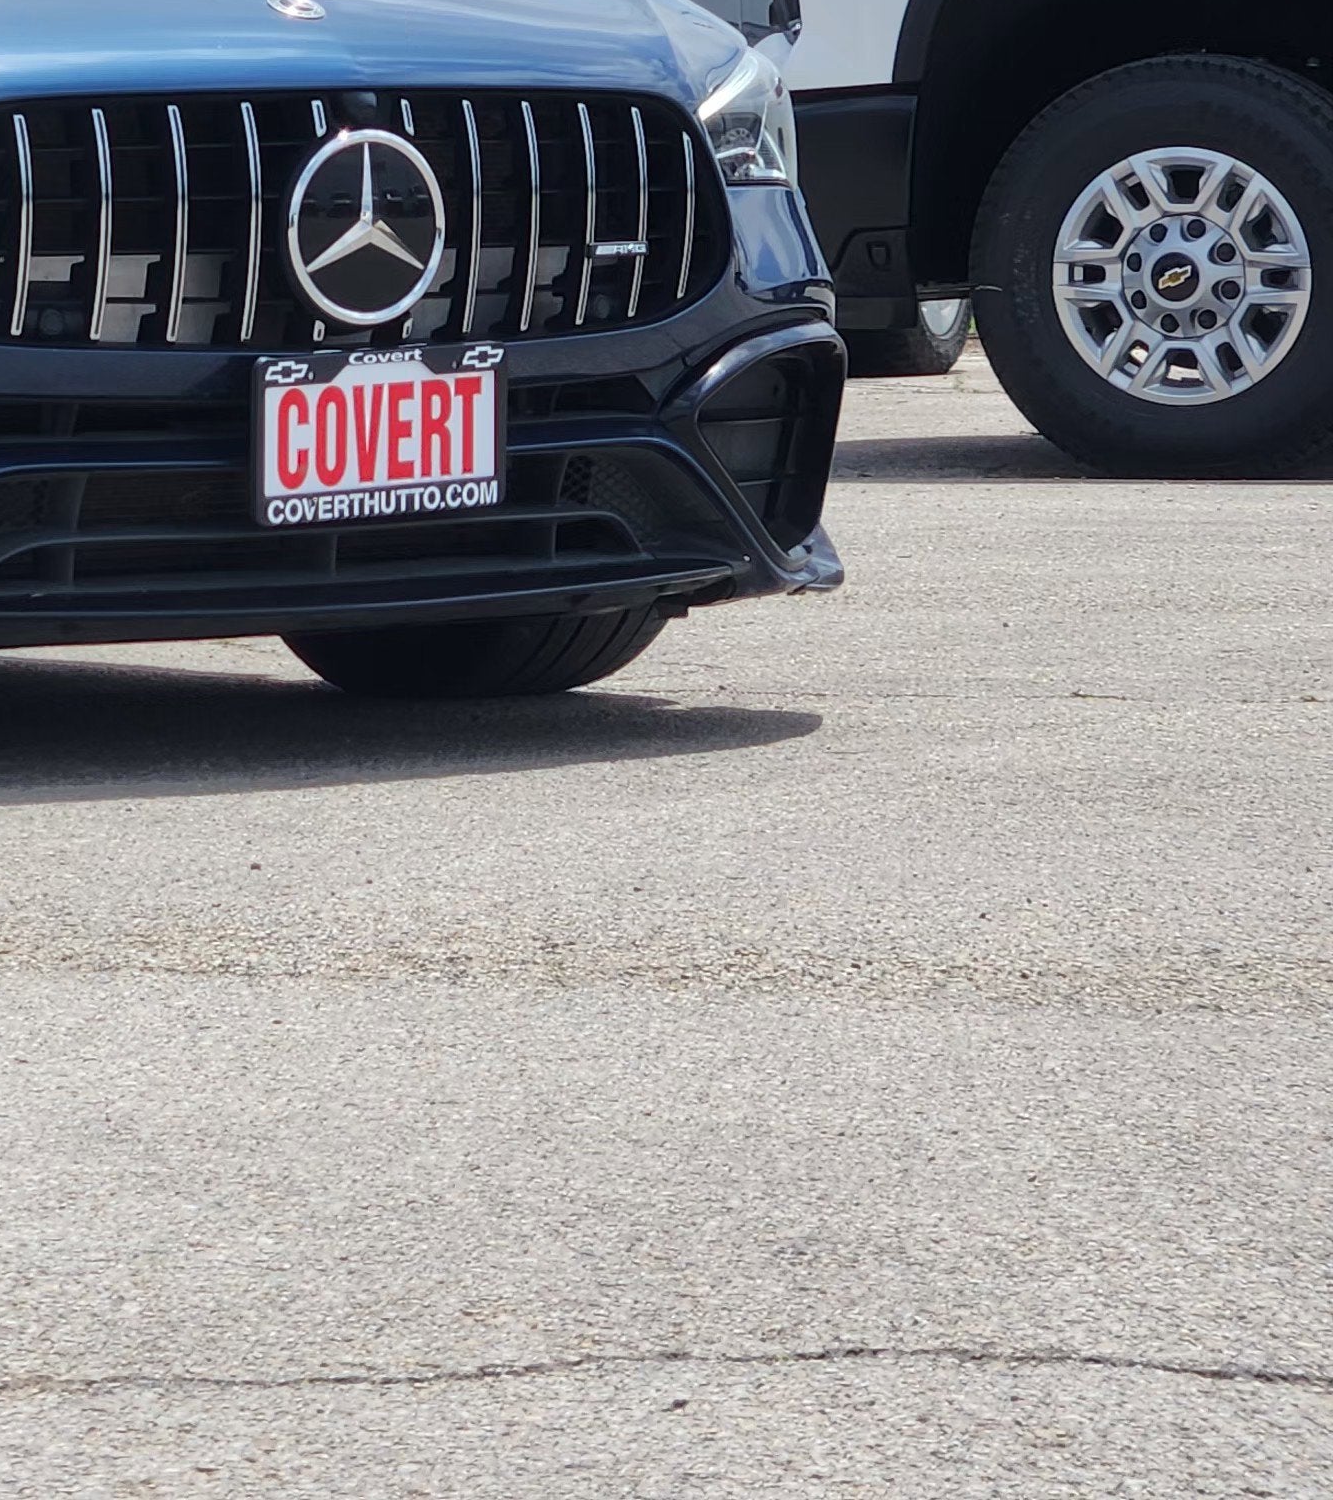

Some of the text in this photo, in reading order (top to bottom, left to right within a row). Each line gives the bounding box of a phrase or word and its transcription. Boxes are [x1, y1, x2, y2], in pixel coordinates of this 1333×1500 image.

[348, 348, 423, 365] Covert
[277, 376, 482, 491] COVERT
[267, 480, 498, 525] COVERTHUTTO.COM
